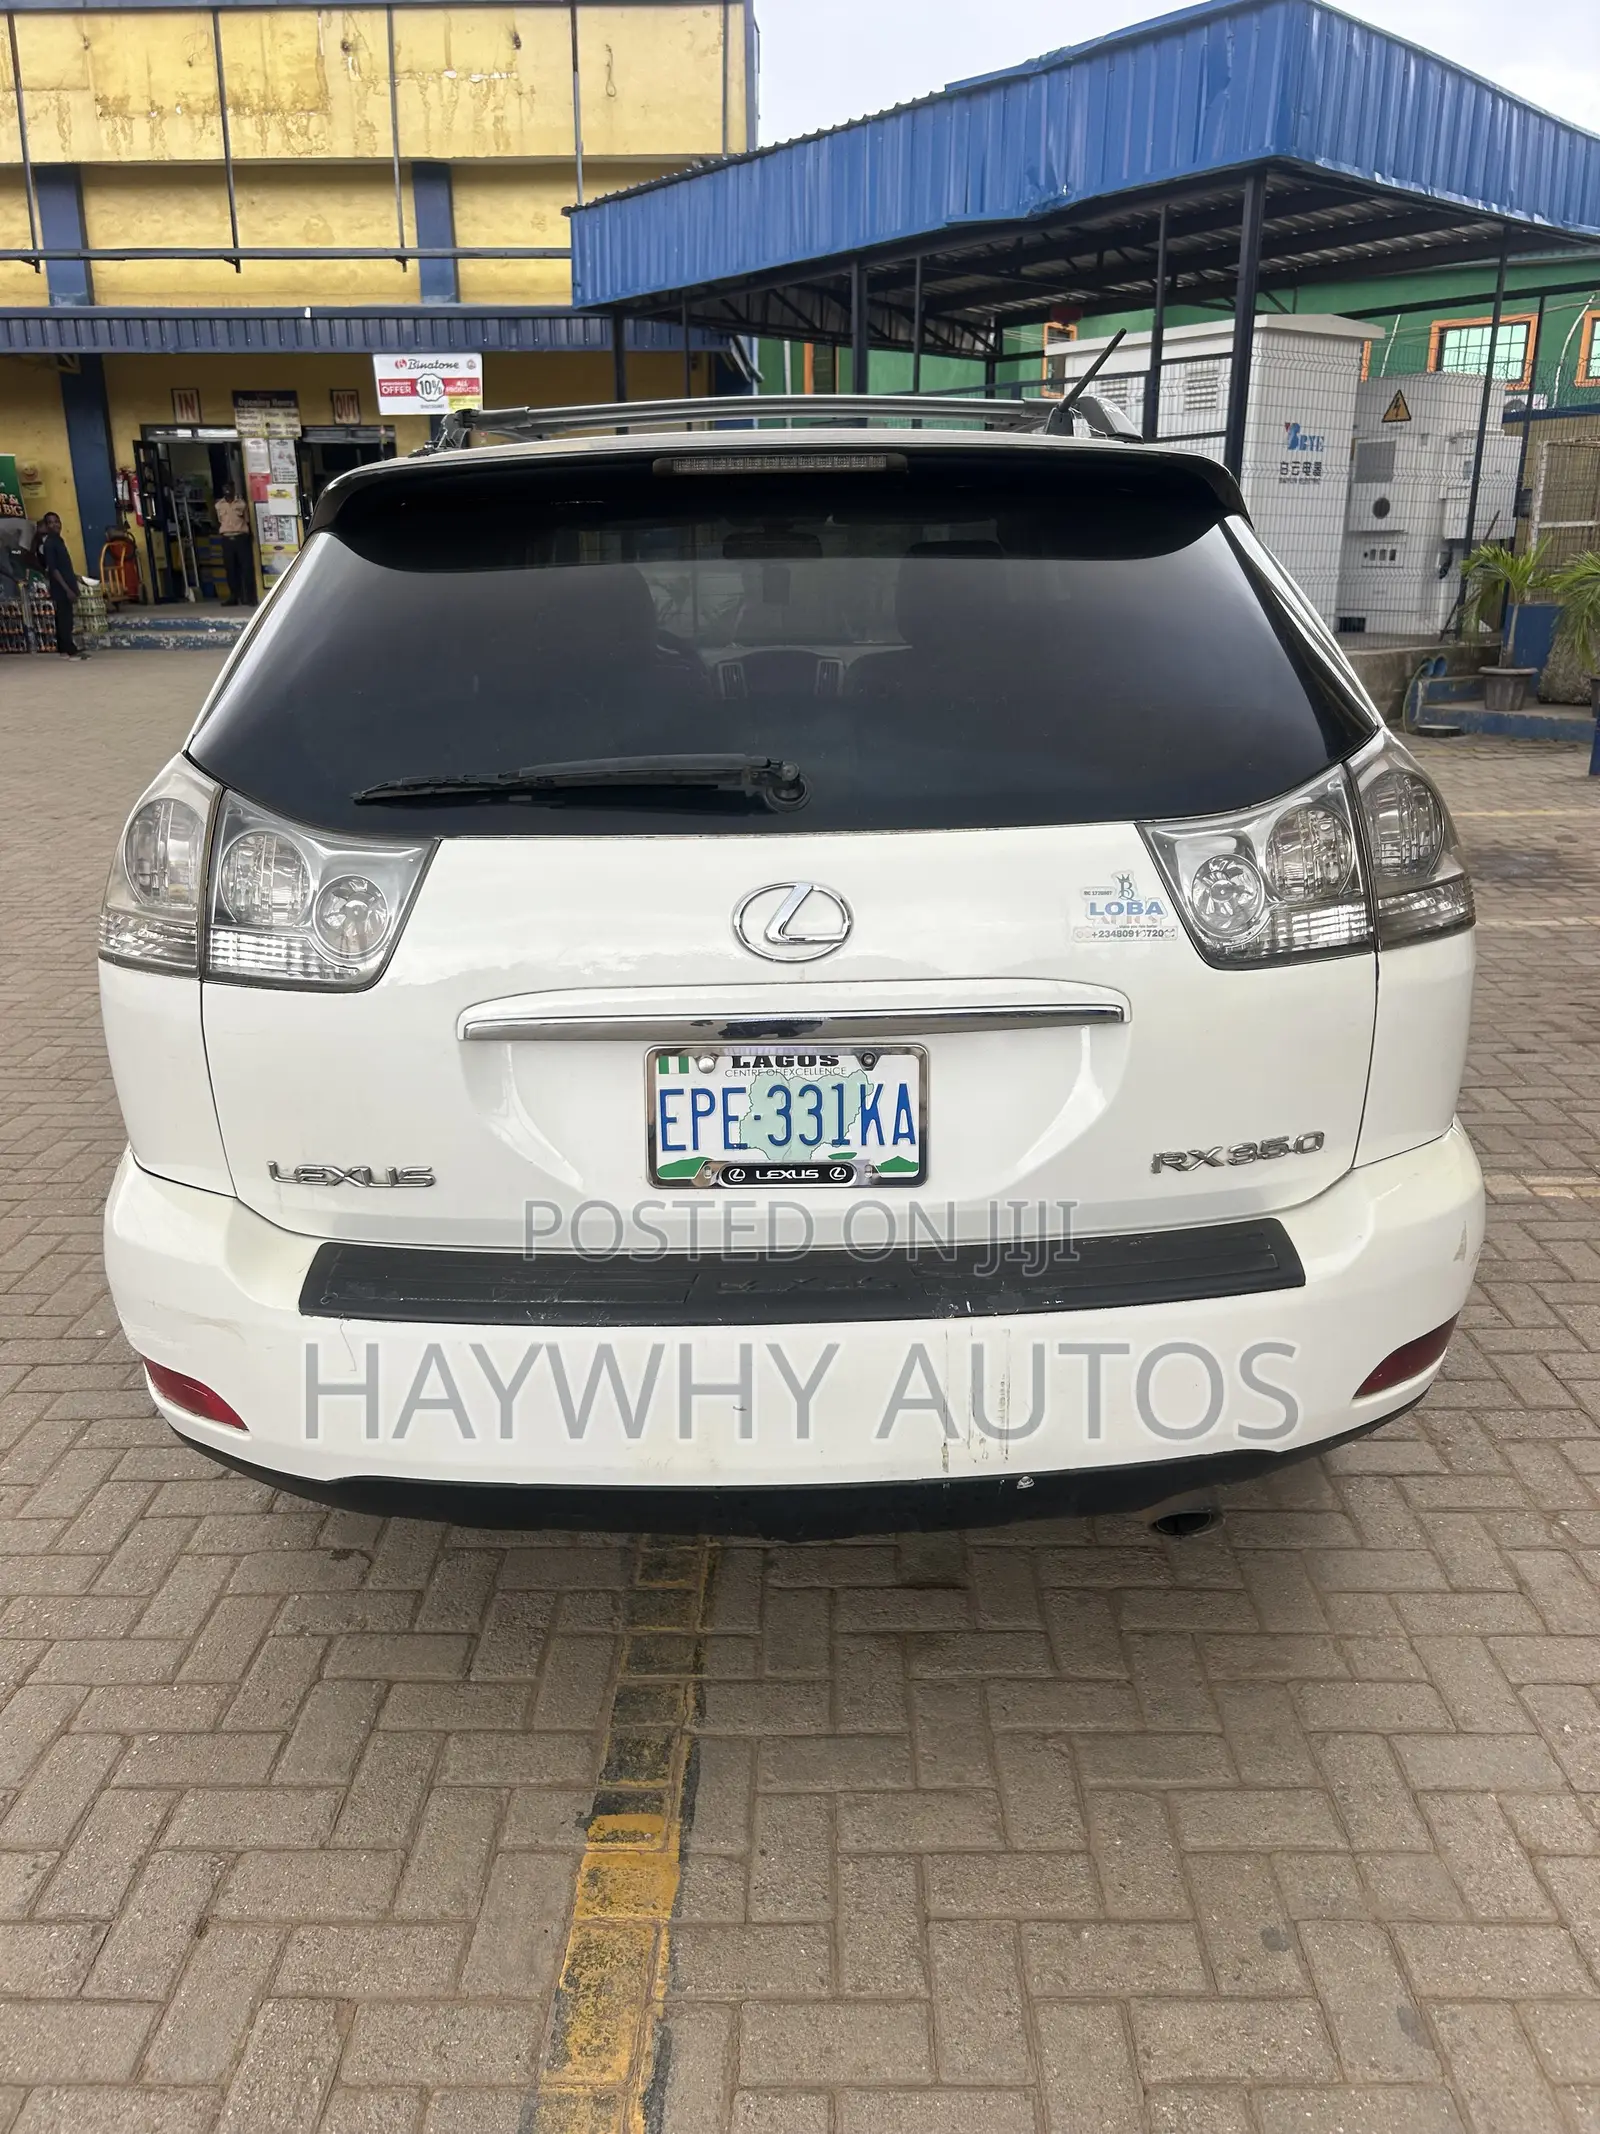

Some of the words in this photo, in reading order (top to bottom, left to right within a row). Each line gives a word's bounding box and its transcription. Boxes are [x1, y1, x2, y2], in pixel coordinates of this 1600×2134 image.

[408, 358, 460, 371] Binatone
[380, 386, 412, 394] OFFER
[419, 380, 443, 395] 10%
[177, 393, 196, 420] IN
[334, 393, 357, 421] OUT
[1090, 901, 1164, 916] LOBA
[731, 1054, 840, 1069] LAGOS
[724, 1068, 765, 1077] CENTRE
[766, 1068, 782, 1077] OF
[783, 1066, 846, 1077] EXCELLENCE
[266, 1160, 437, 1188] LEXUS
[755, 1168, 820, 1180] LEXUS
